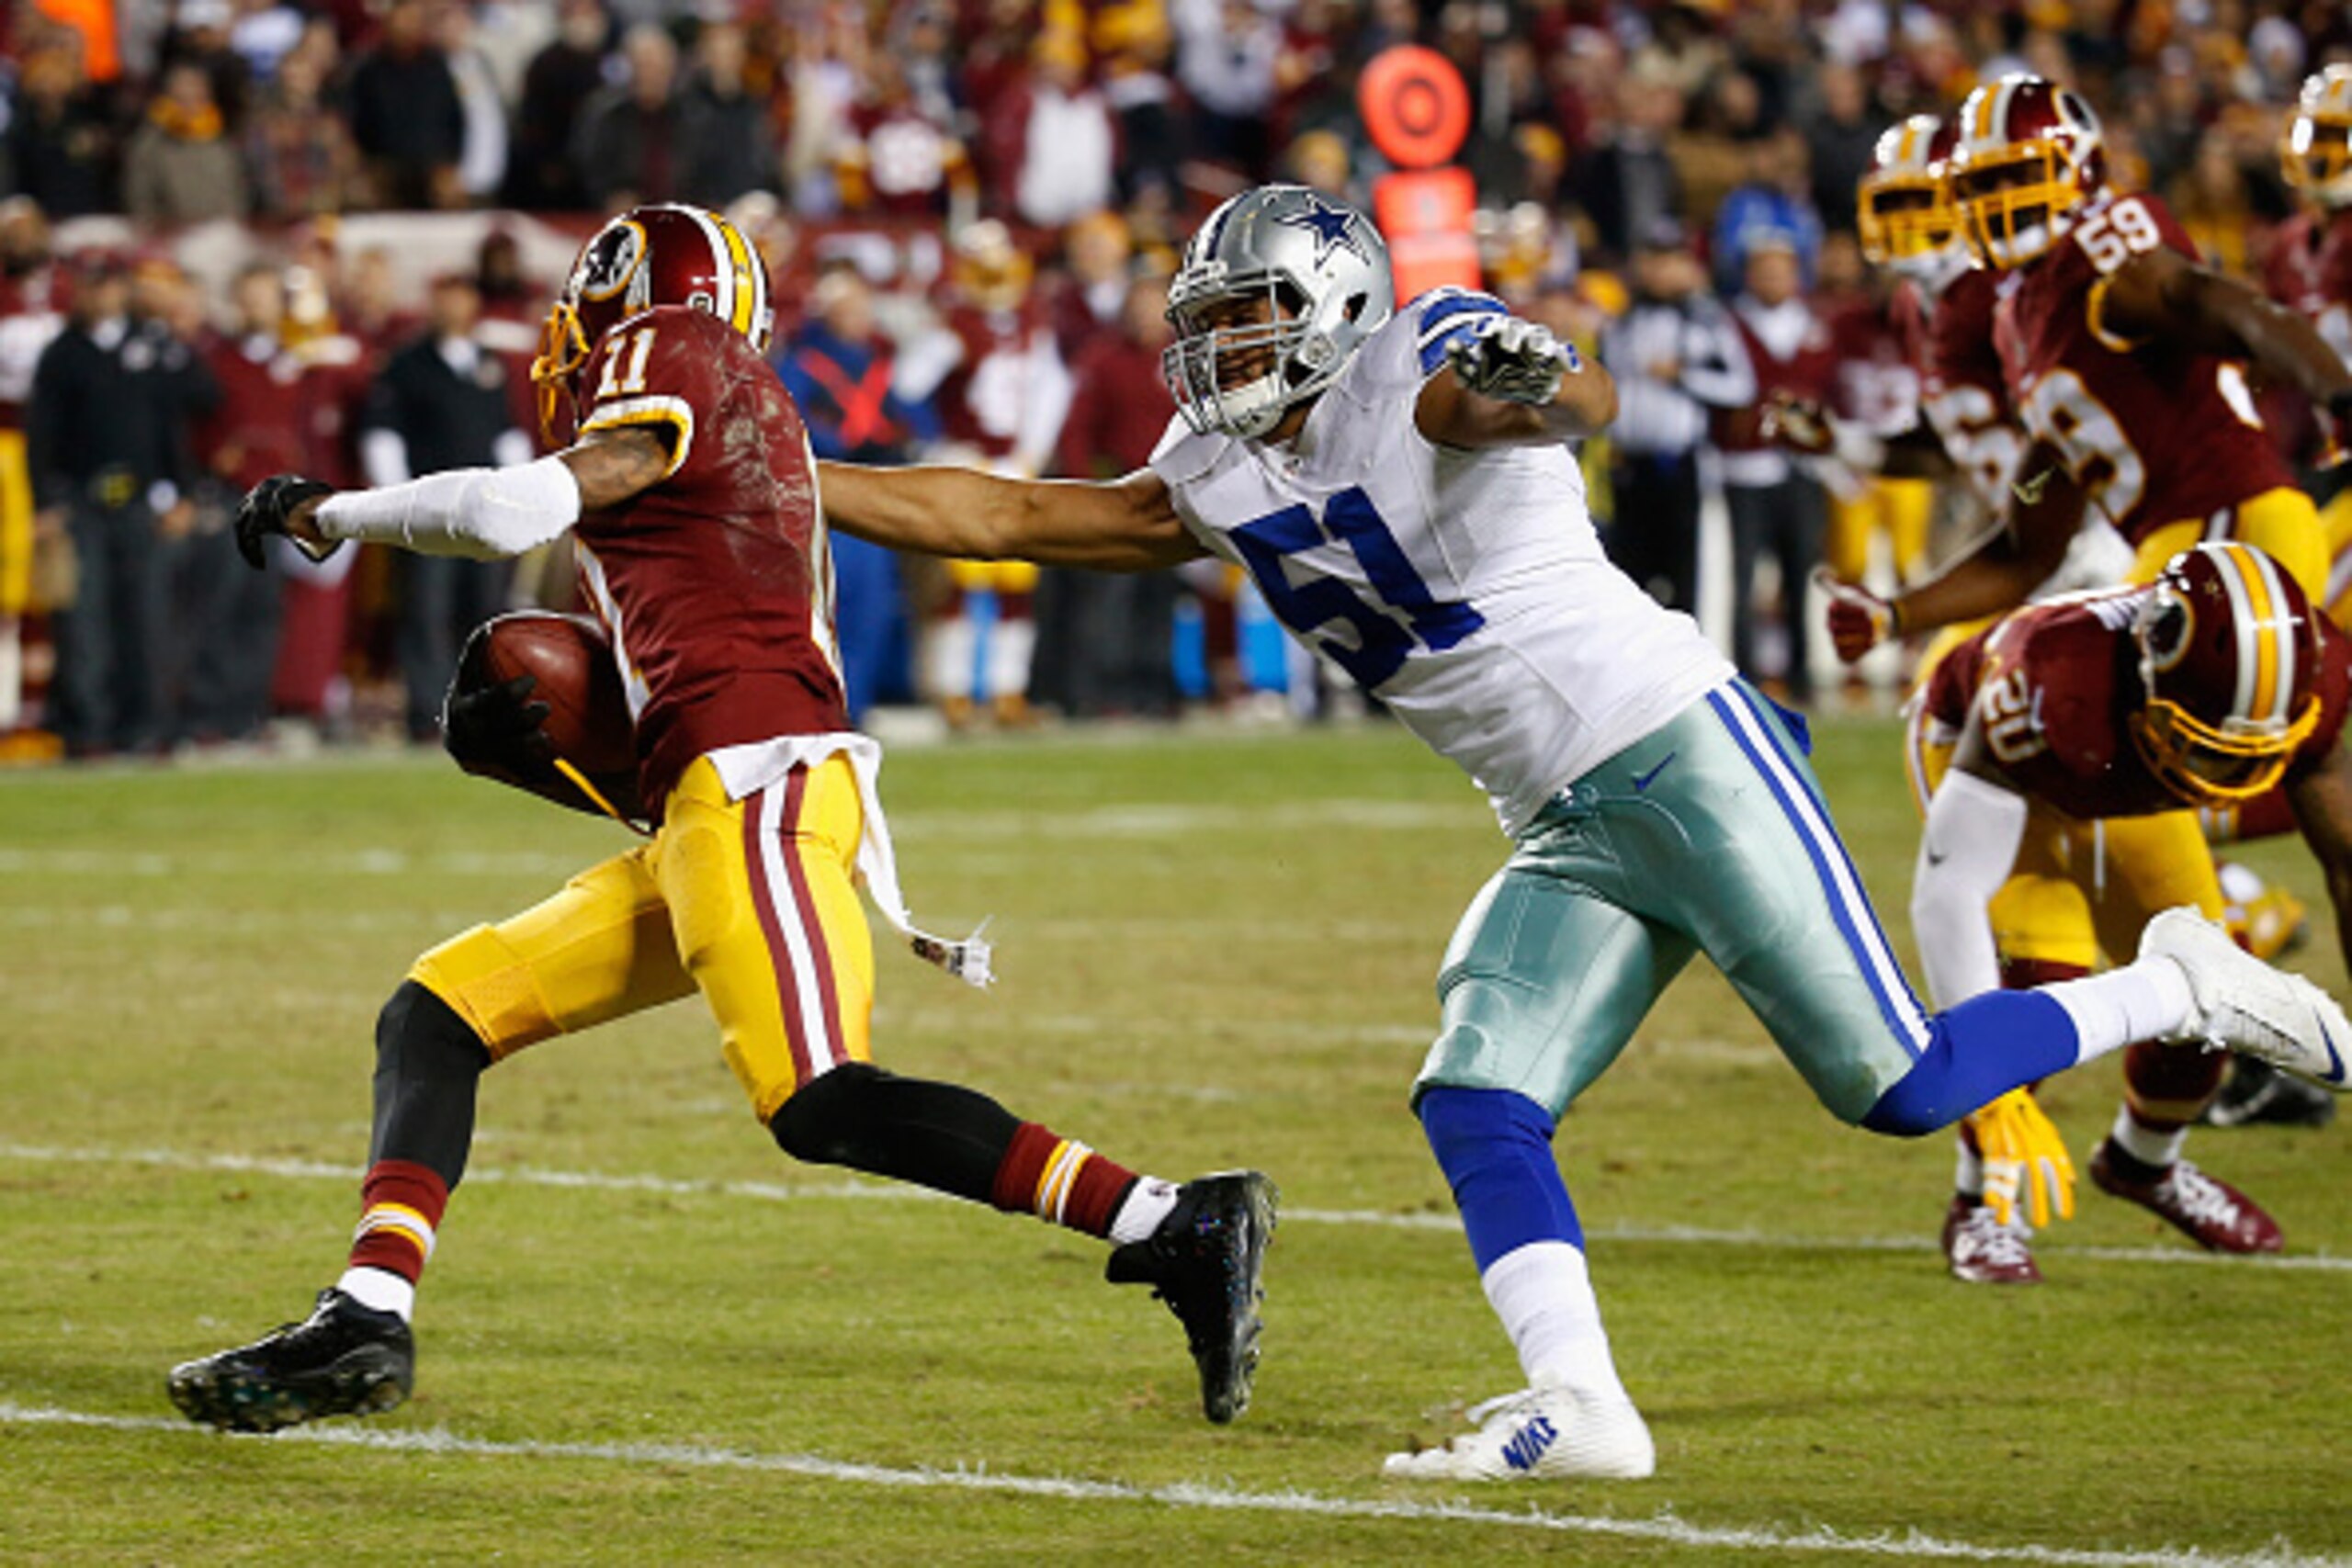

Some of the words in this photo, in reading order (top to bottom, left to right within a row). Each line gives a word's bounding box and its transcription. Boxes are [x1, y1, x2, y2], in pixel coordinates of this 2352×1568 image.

[2074, 197, 2161, 274] 59
[597, 328, 658, 399] 11
[2019, 367, 2146, 522] 9
[1227, 483, 1487, 689] 51
[1981, 667, 2041, 762] 20
[1500, 1416, 1557, 1472] NIKE
